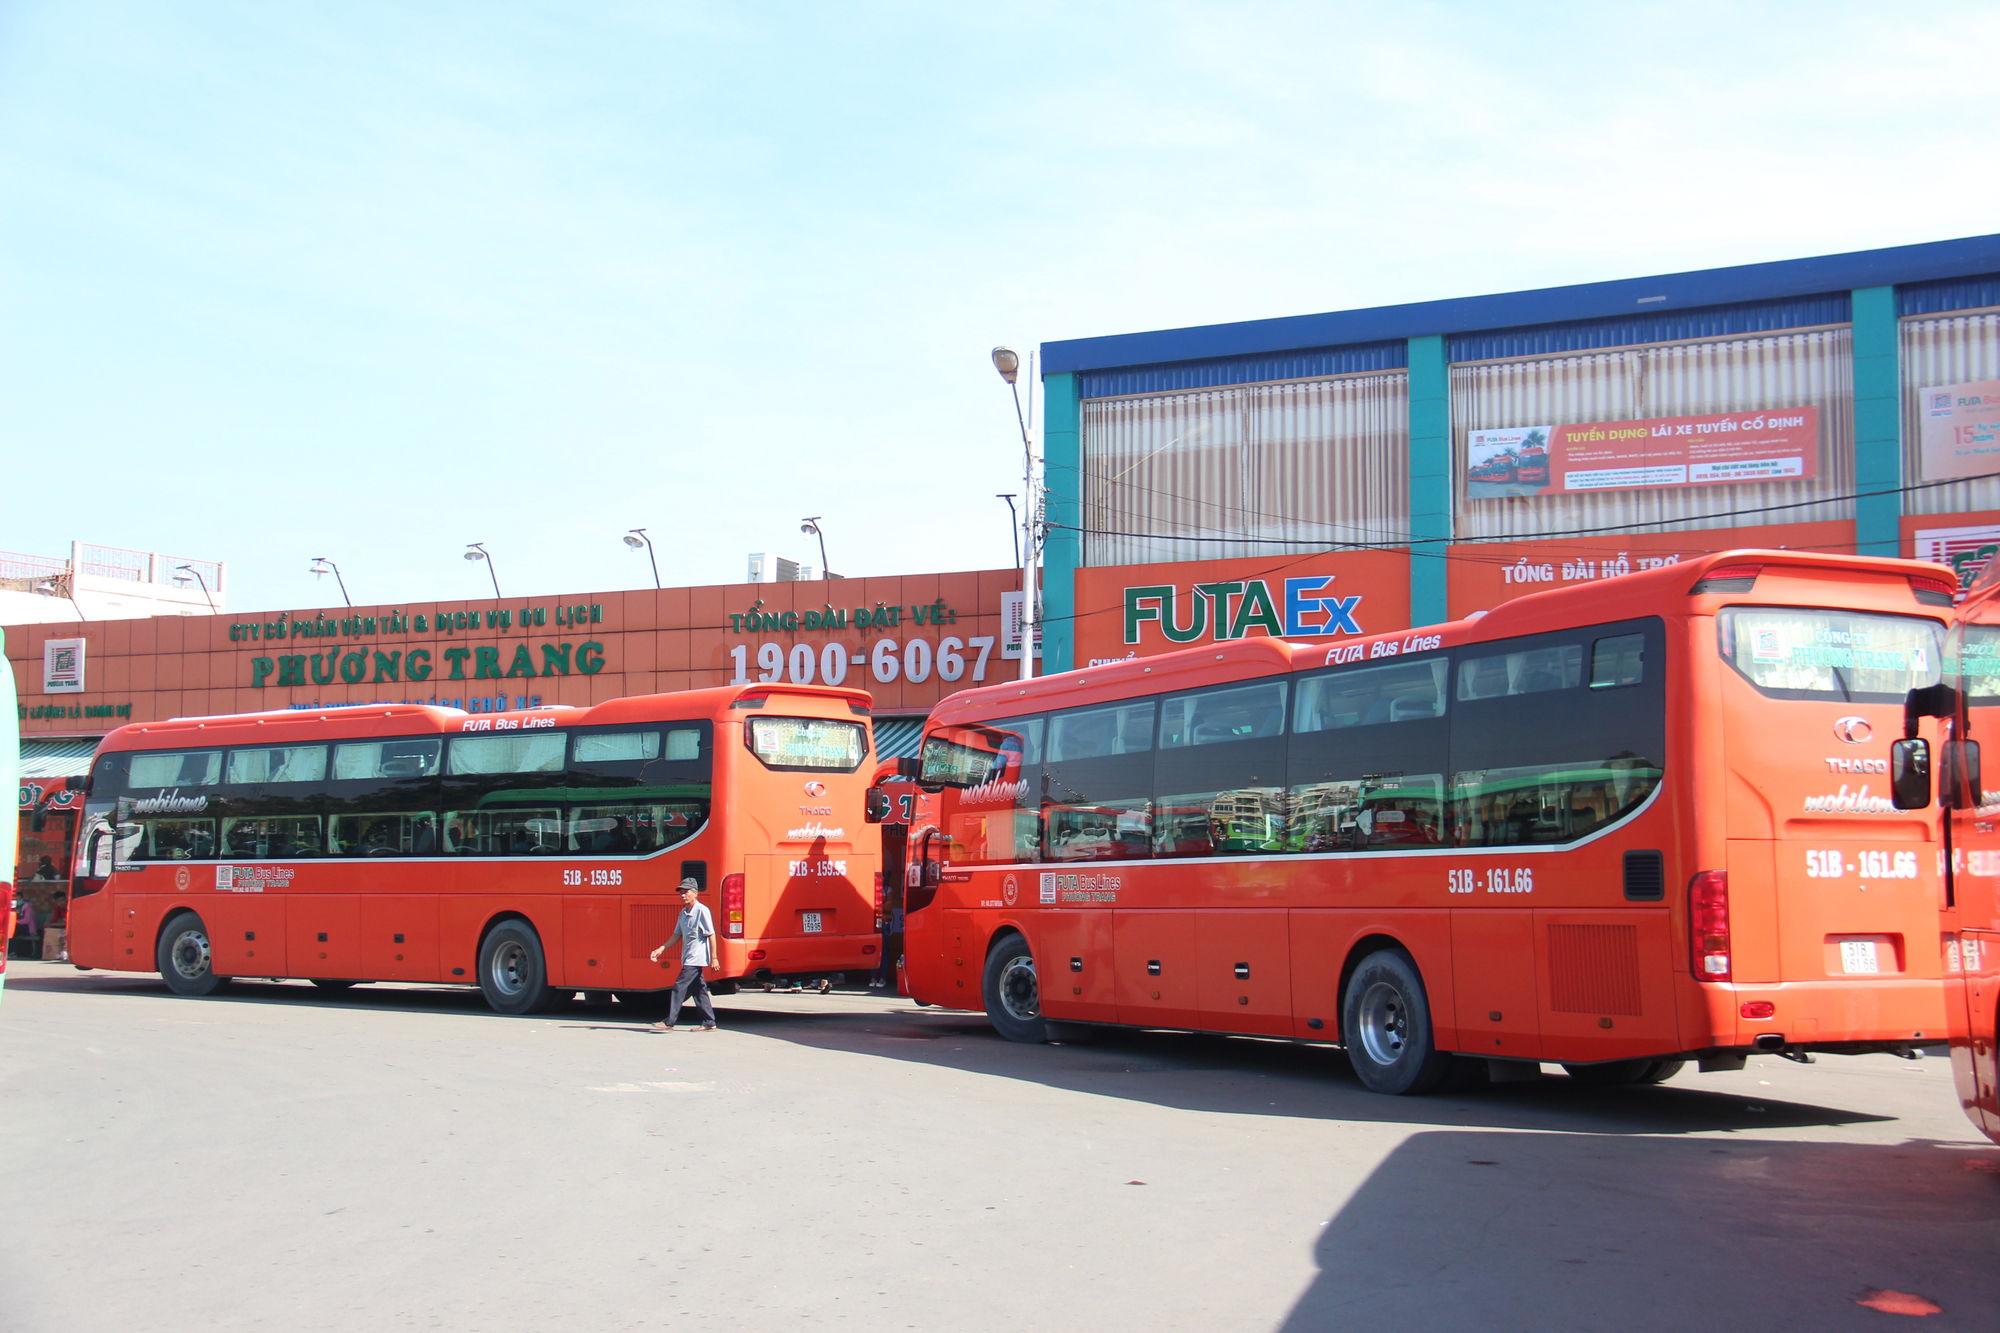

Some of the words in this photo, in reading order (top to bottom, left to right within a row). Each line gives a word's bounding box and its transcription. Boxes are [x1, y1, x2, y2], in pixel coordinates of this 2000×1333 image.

[1566, 426, 1605, 443] TUYỂN
[1609, 426, 1648, 442] DỤNG
[1651, 423, 1672, 437] LÁI
[1675, 424, 1693, 435] XE
[1696, 418, 1737, 433] TUYẾN
[1741, 415, 1765, 431] CỐ
[1767, 416, 1804, 431] ĐỊNH
[1501, 557, 1554, 584] TỔNG
[1561, 557, 1595, 581] ĐÀI
[229, 623, 261, 642] CTY
[264, 612, 288, 640] CỔ
[341, 613, 377, 640] VẬN
[379, 609, 410, 634] TẢI
[414, 614, 428, 632] &
[435, 611, 480, 635] DỊCH
[486, 609, 512, 633] VỤ
[519, 607, 547, 627] DU
[556, 604, 603, 629] LỊCH
[729, 599, 799, 632] TỔNG
[804, 603, 847, 630] ĐÀI
[853, 601, 904, 632] ĐẶT
[730, 636, 995, 686] 1900-6067
[1325, 644, 1364, 665] FUTA
[1370, 640, 1399, 659] Bus
[1402, 634, 1441, 654] Lines
[251, 645, 432, 688] PHƯƠNG
[444, 640, 606, 680] TRANG
[462, 719, 491, 732] FUTA
[495, 718, 519, 731] Bus
[522, 716, 556, 729] Lines
[1825, 757, 1887, 774] THACO
[959, 767, 1030, 805] mobihome
[134, 788, 208, 814] mobihome
[799, 806, 832, 816] THACO
[787, 822, 845, 839] mobihome
[233, 866, 255, 880] FUTA
[255, 866, 271, 880] Bus
[272, 866, 294, 880] Lines
[563, 869, 582, 886] 51B
[590, 869, 622, 886] 159.95
[789, 860, 808, 876] 51B
[817, 860, 847, 877] 159.95
[1806, 850, 1842, 878] 51B
[1858, 851, 1918, 879] 161.66
[1056, 874, 1079, 891] FUTA
[1079, 873, 1096, 890] Bus
[1097, 873, 1121, 890] Lines
[1448, 868, 1474, 893] 51B
[1486, 867, 1533, 893] 161.66
